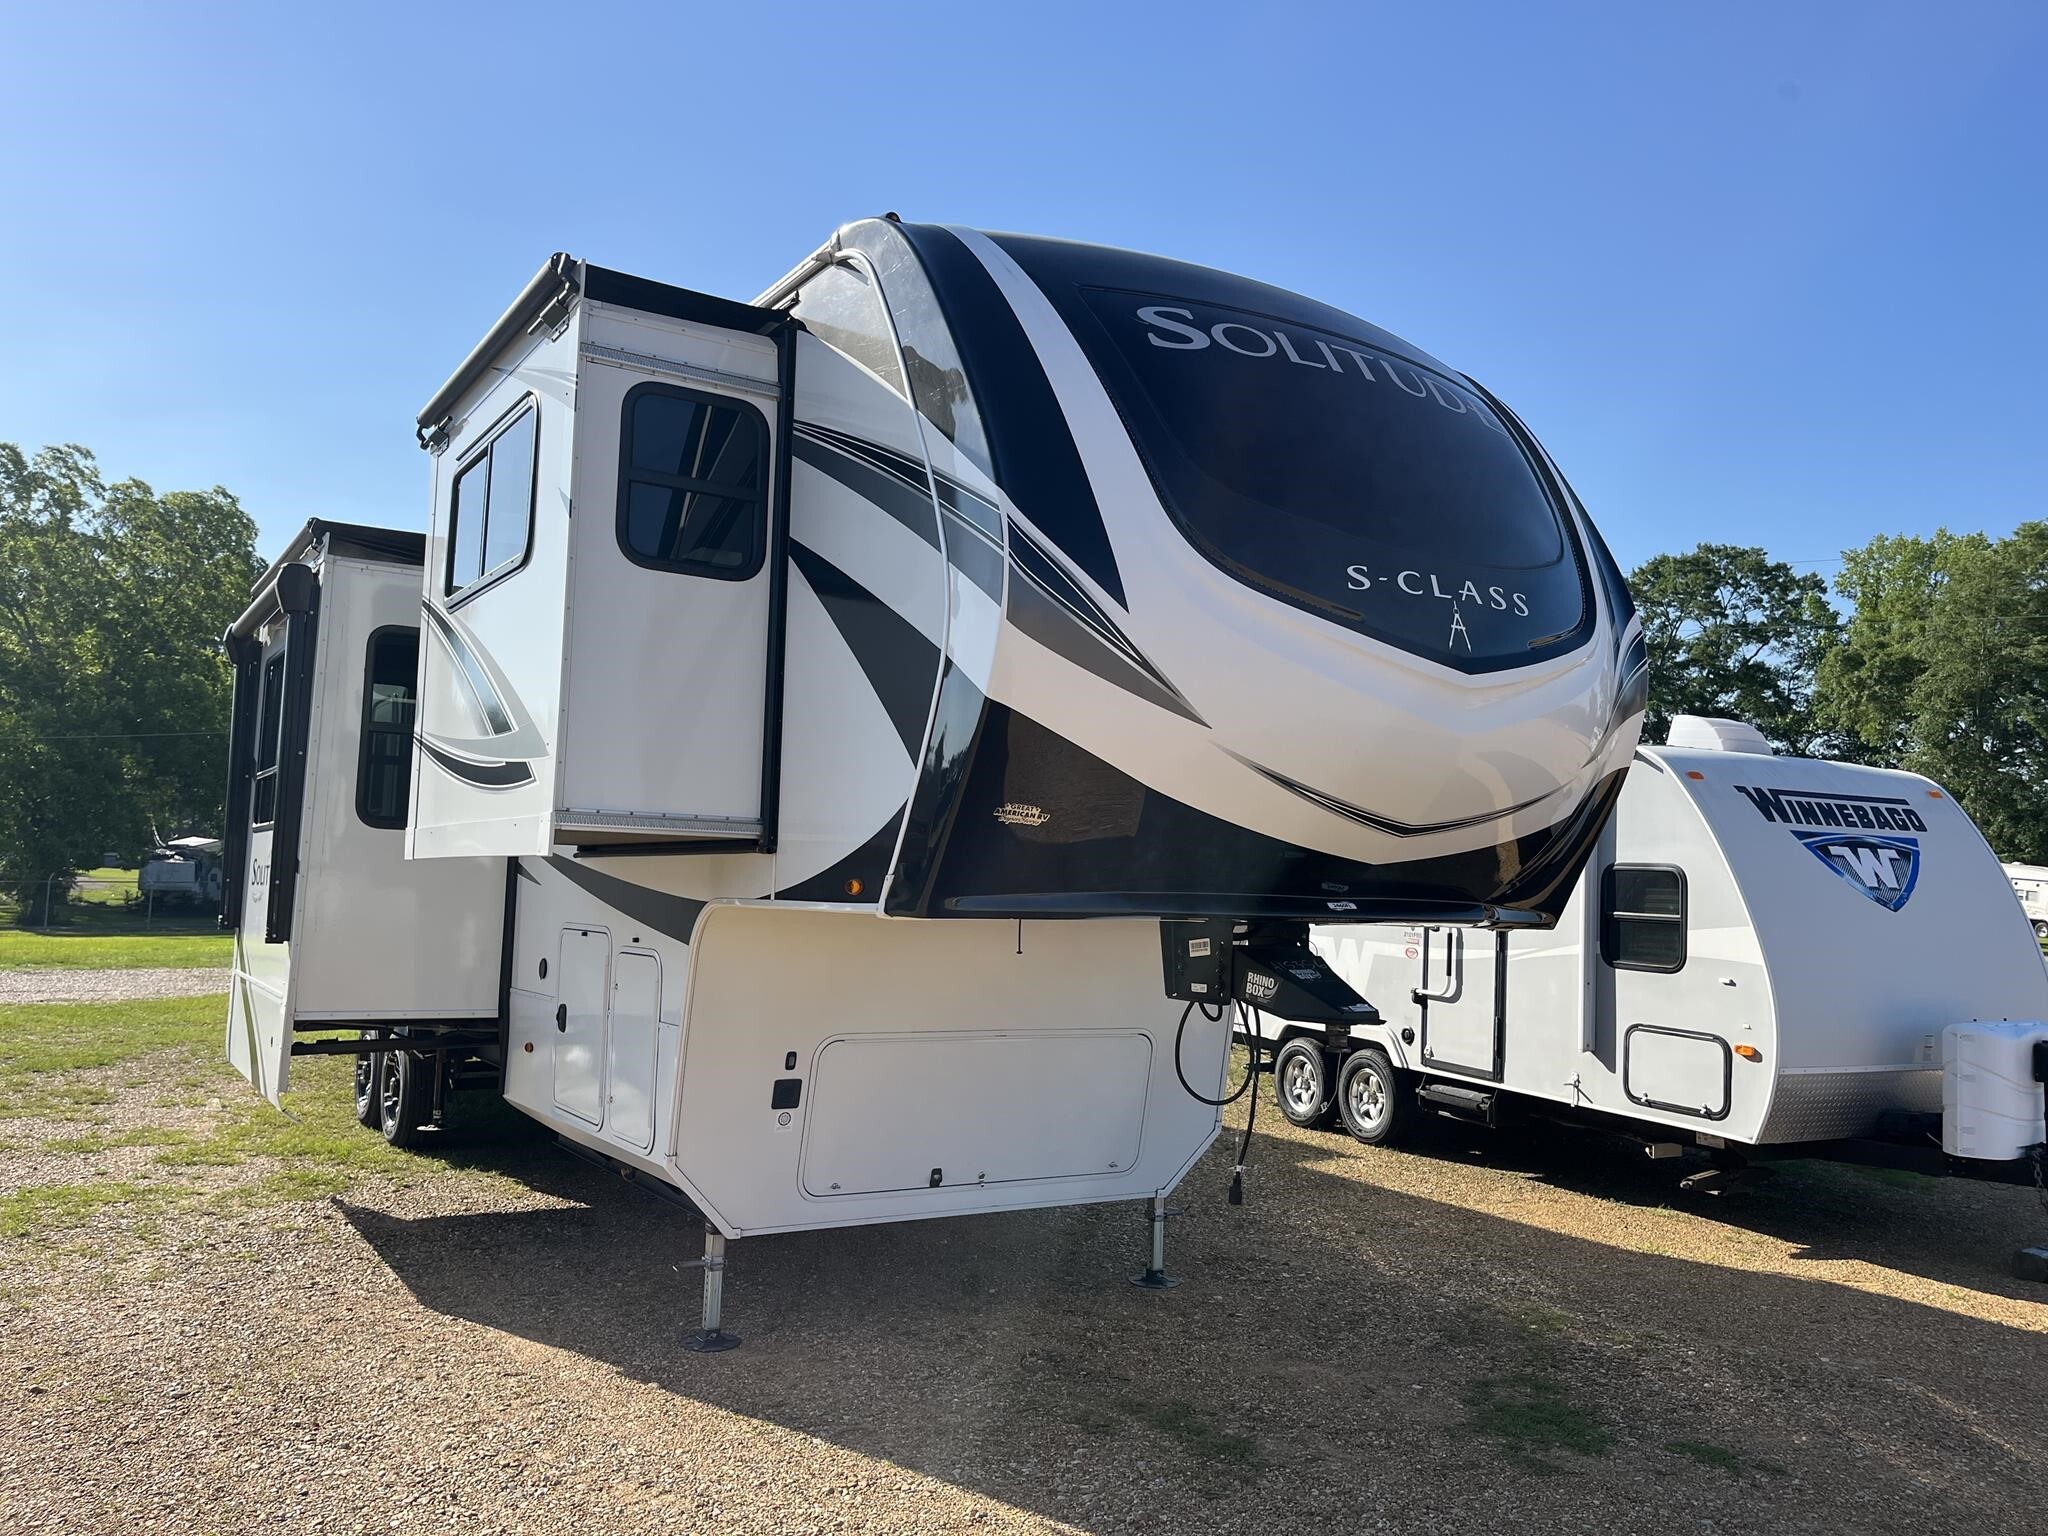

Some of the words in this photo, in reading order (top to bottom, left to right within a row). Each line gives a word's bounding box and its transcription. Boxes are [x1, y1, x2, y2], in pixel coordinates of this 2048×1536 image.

[1346, 565, 1529, 617] S-CLASS
[994, 808, 1036, 819] AMERICAN
[1036, 813, 1048, 821] RV
[1010, 803, 1034, 812] GREAT
[1733, 785, 1927, 832] WINNEBAGO
[1829, 846, 1900, 889] W
[1247, 971, 1275, 989] RHINO
[1245, 982, 1265, 998] BOX
